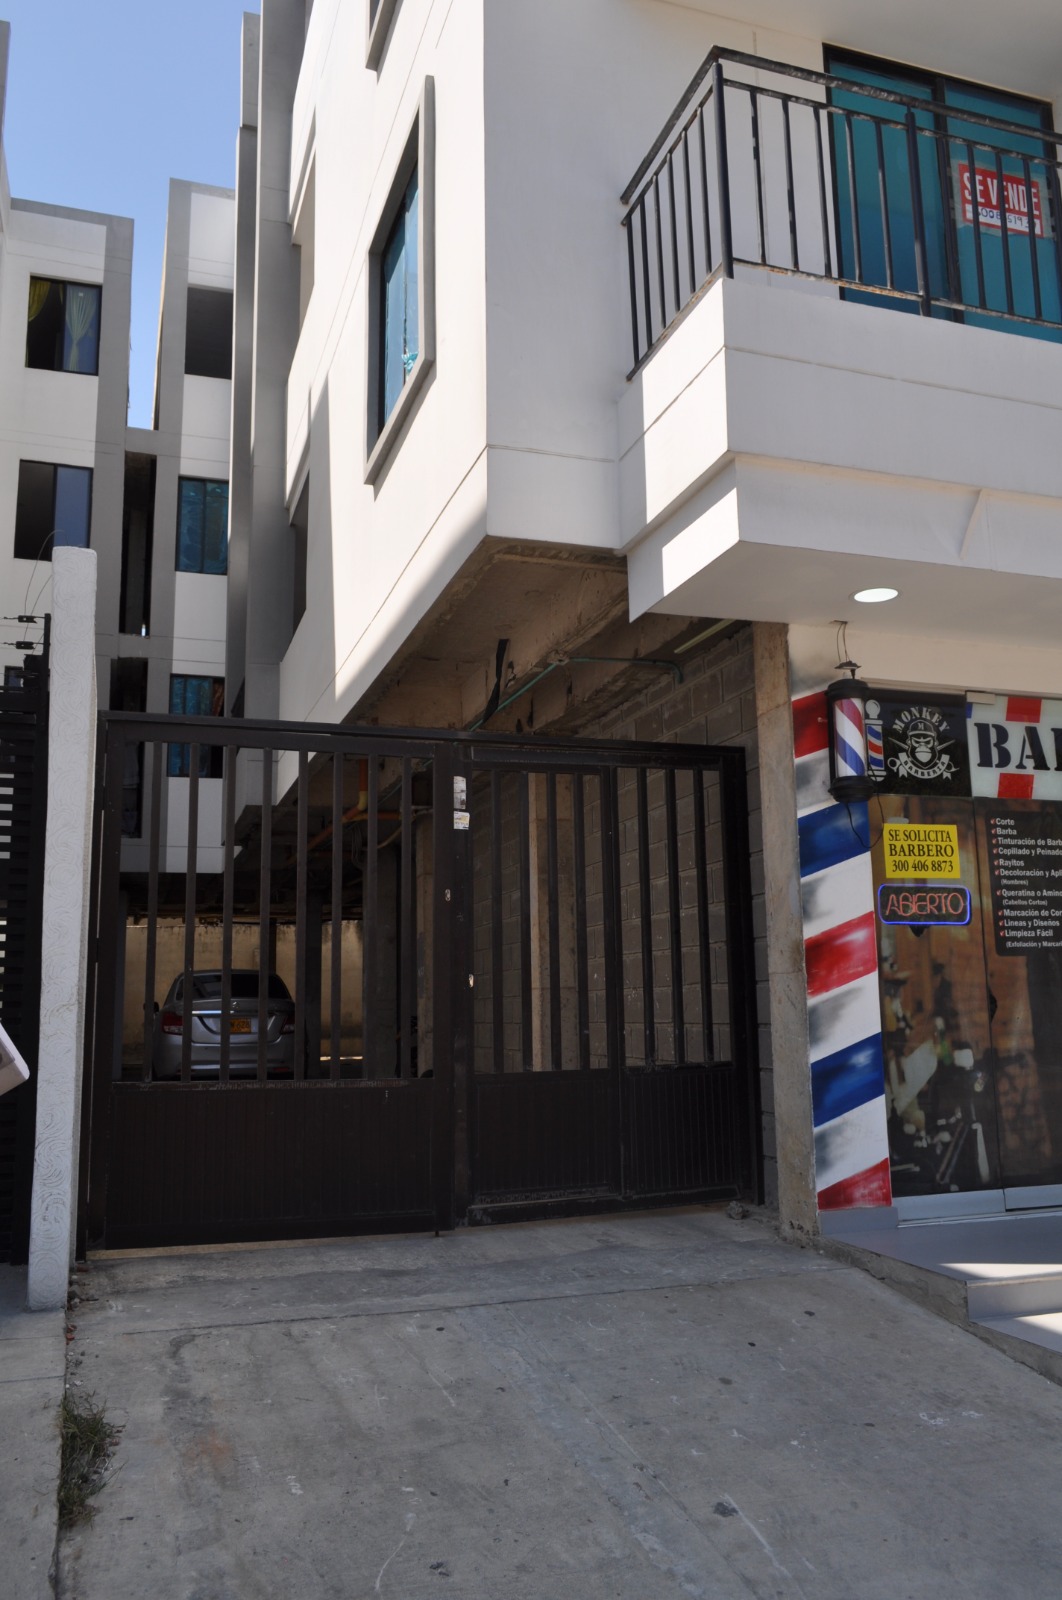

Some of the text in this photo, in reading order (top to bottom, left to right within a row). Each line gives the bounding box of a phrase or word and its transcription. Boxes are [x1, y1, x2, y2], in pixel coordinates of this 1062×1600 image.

[963, 172, 985, 203] SE
[892, 706, 950, 733] MONKEY
[996, 818, 1015, 826] Corte
[888, 829, 952, 843] SE SOLICITA
[889, 844, 954, 858] BARBERO
[999, 847, 1031, 856] Cepillado
[892, 860, 954, 873] 300 406 8873
[1000, 859, 1025, 867] Rayitos
[1001, 869, 1045, 877] Decoloración
[1001, 879, 1029, 887] (Hombres)
[1002, 889, 1036, 898] Queratina
[885, 892, 964, 917] ABIERTO
[1004, 909, 1040, 917] Marcación
[1041, 909, 1050, 917] de
[1033, 919, 1060, 927] Diseños
[1005, 929, 1036, 938] Limpieza
